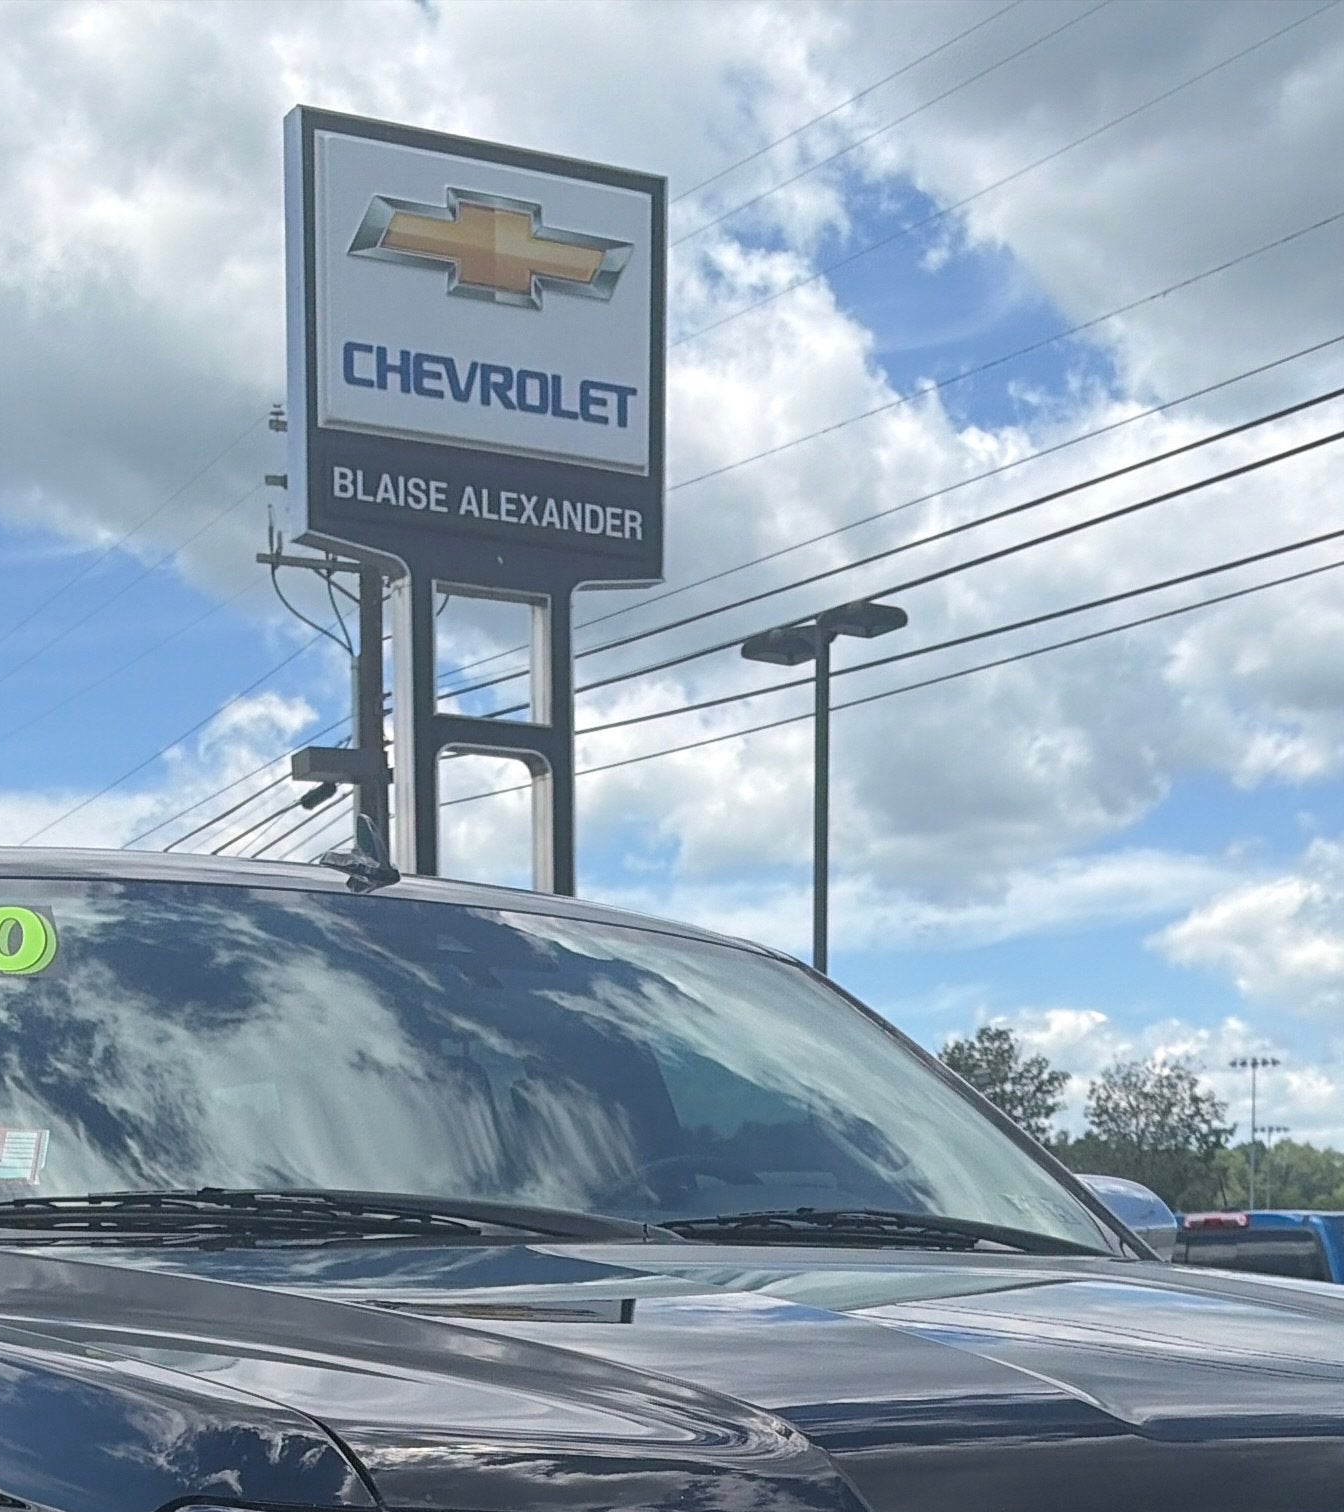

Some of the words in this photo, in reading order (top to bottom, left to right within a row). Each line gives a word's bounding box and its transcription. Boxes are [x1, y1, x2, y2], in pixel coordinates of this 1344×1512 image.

[343, 341, 638, 428] CHEVROLET
[333, 466, 449, 513] BLAISE
[459, 486, 643, 541] ALEXANDER
